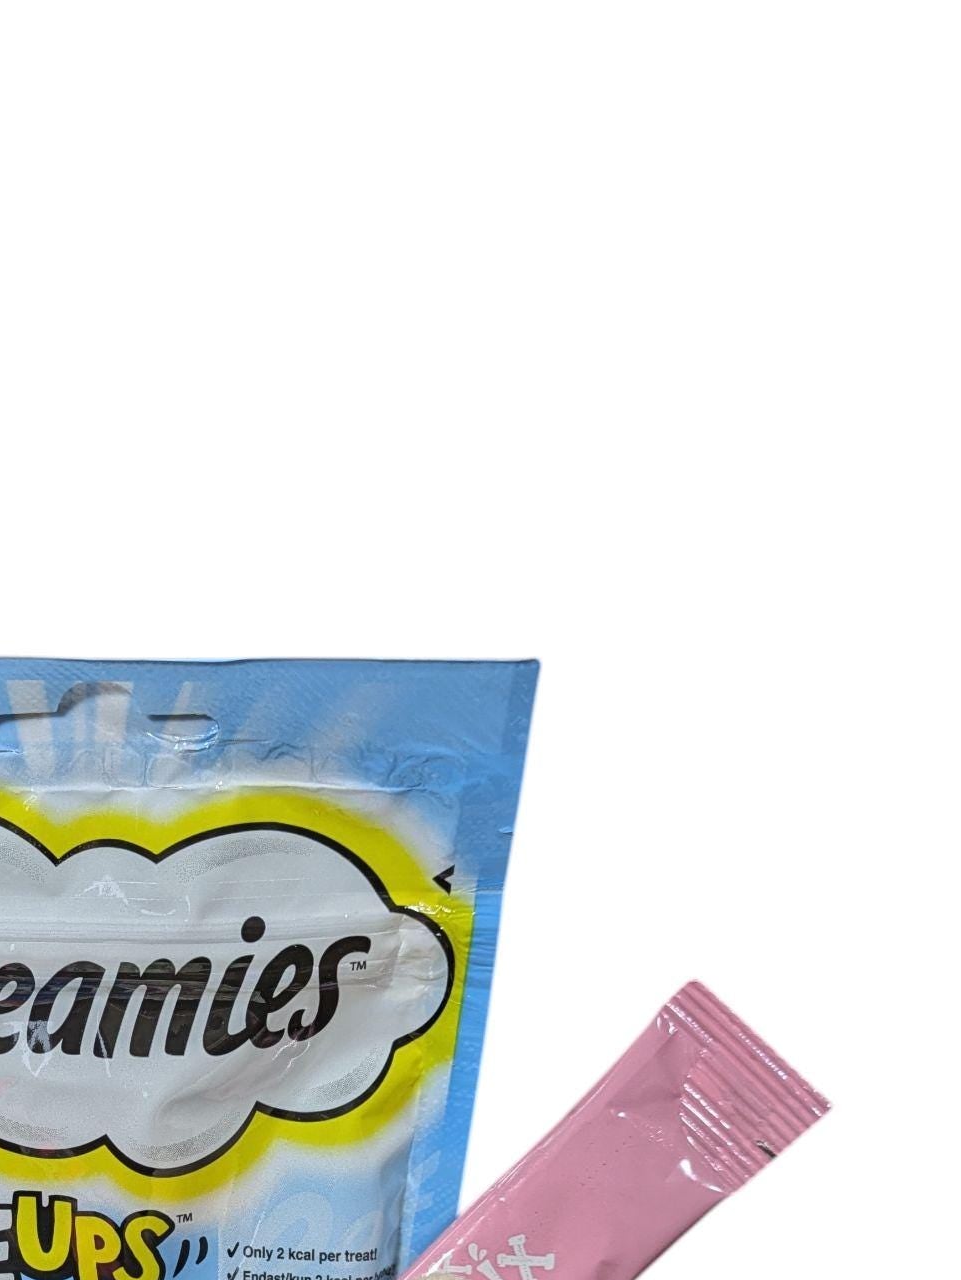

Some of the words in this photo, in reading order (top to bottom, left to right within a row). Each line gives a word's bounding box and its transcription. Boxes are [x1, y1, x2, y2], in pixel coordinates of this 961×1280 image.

[242, 1246, 273, 1261] Only
[276, 1247, 285, 1260] 2
[288, 1248, 315, 1261] kcal
[318, 1250, 342, 1264] per
[344, 1248, 378, 1262] treat!
